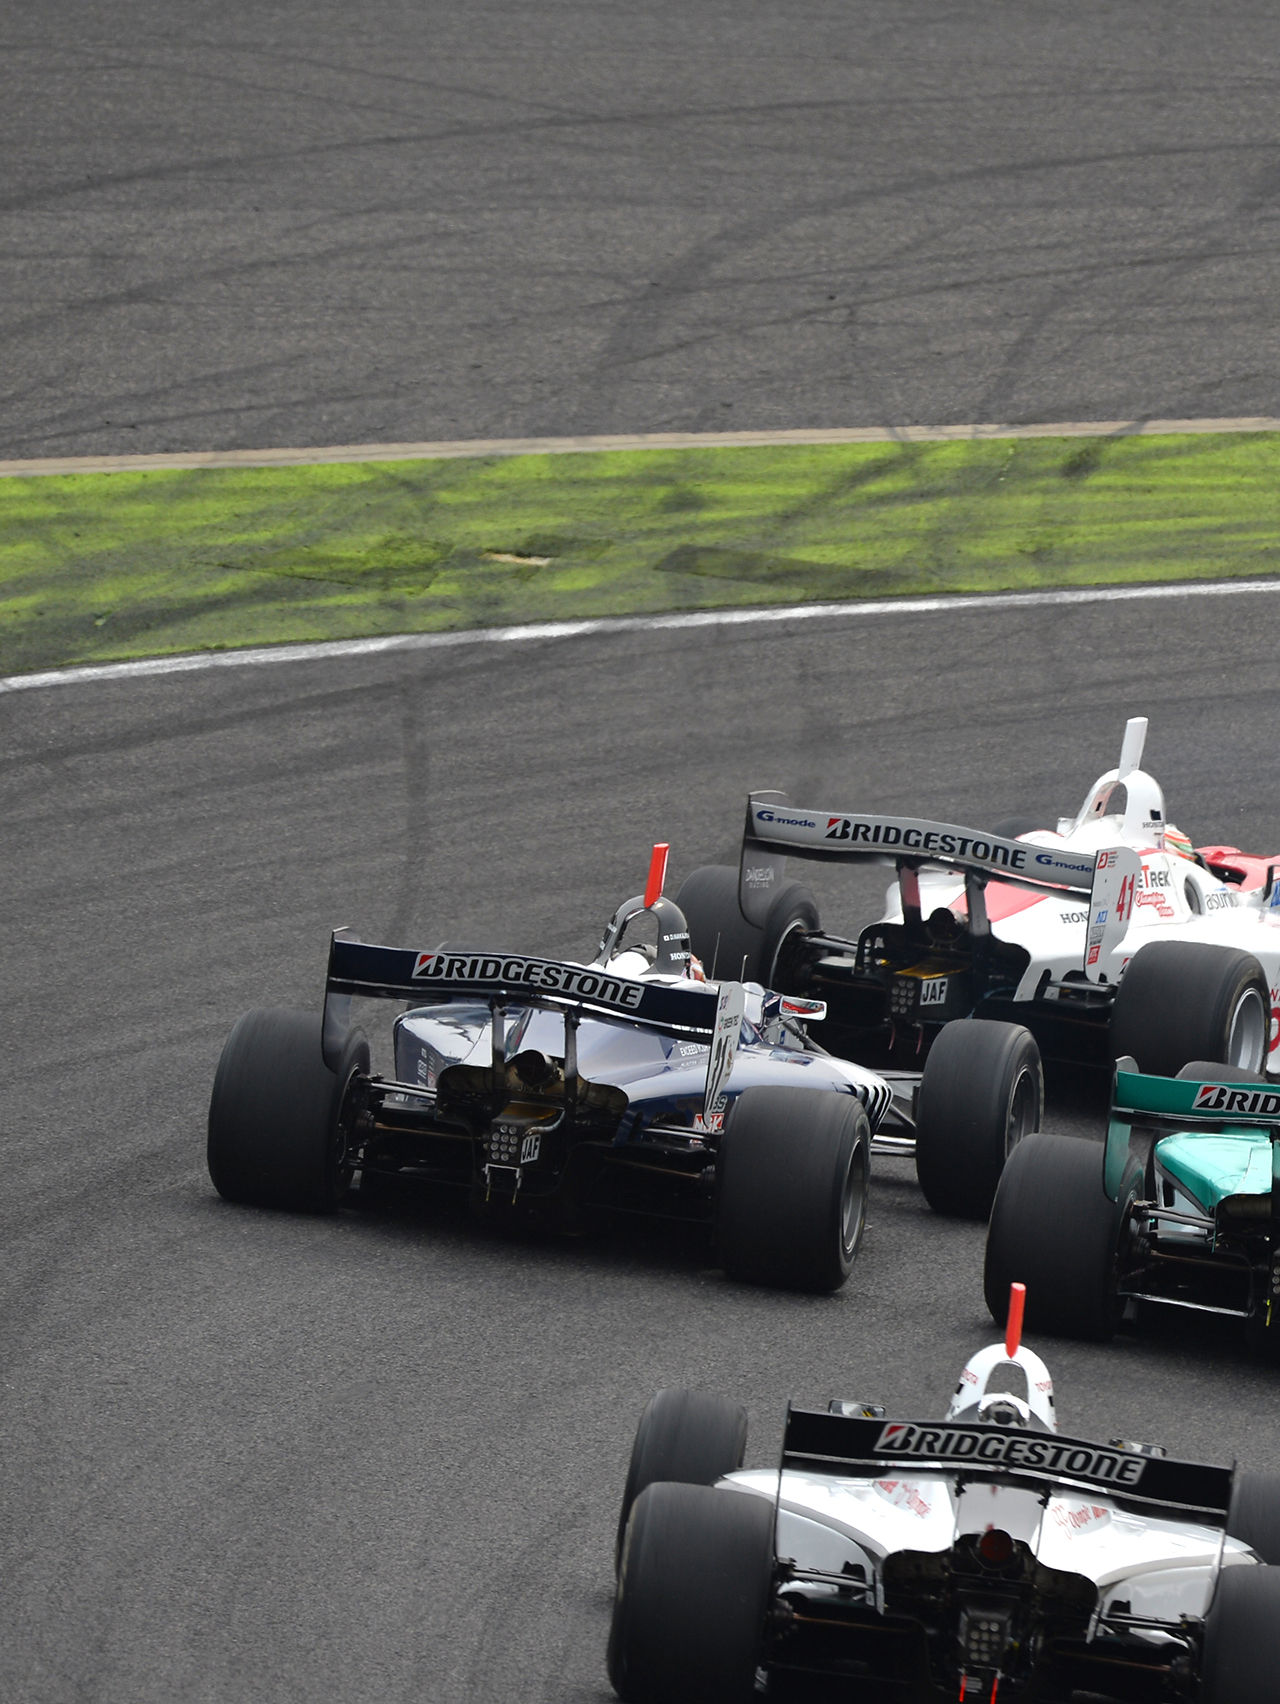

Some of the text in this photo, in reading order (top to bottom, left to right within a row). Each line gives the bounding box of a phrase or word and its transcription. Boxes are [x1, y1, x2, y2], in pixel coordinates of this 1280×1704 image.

[756, 810, 816, 829] G-mode
[824, 817, 1028, 870] BRIDGESTONE
[1035, 854, 1093, 874] G-mode
[1115, 873, 1136, 922] 41
[415, 953, 643, 1008] BRIDGESTONE
[923, 981, 947, 1002] JAF
[523, 1136, 540, 1161] JAF
[878, 1425, 1144, 1484] BRIDGESTONE
